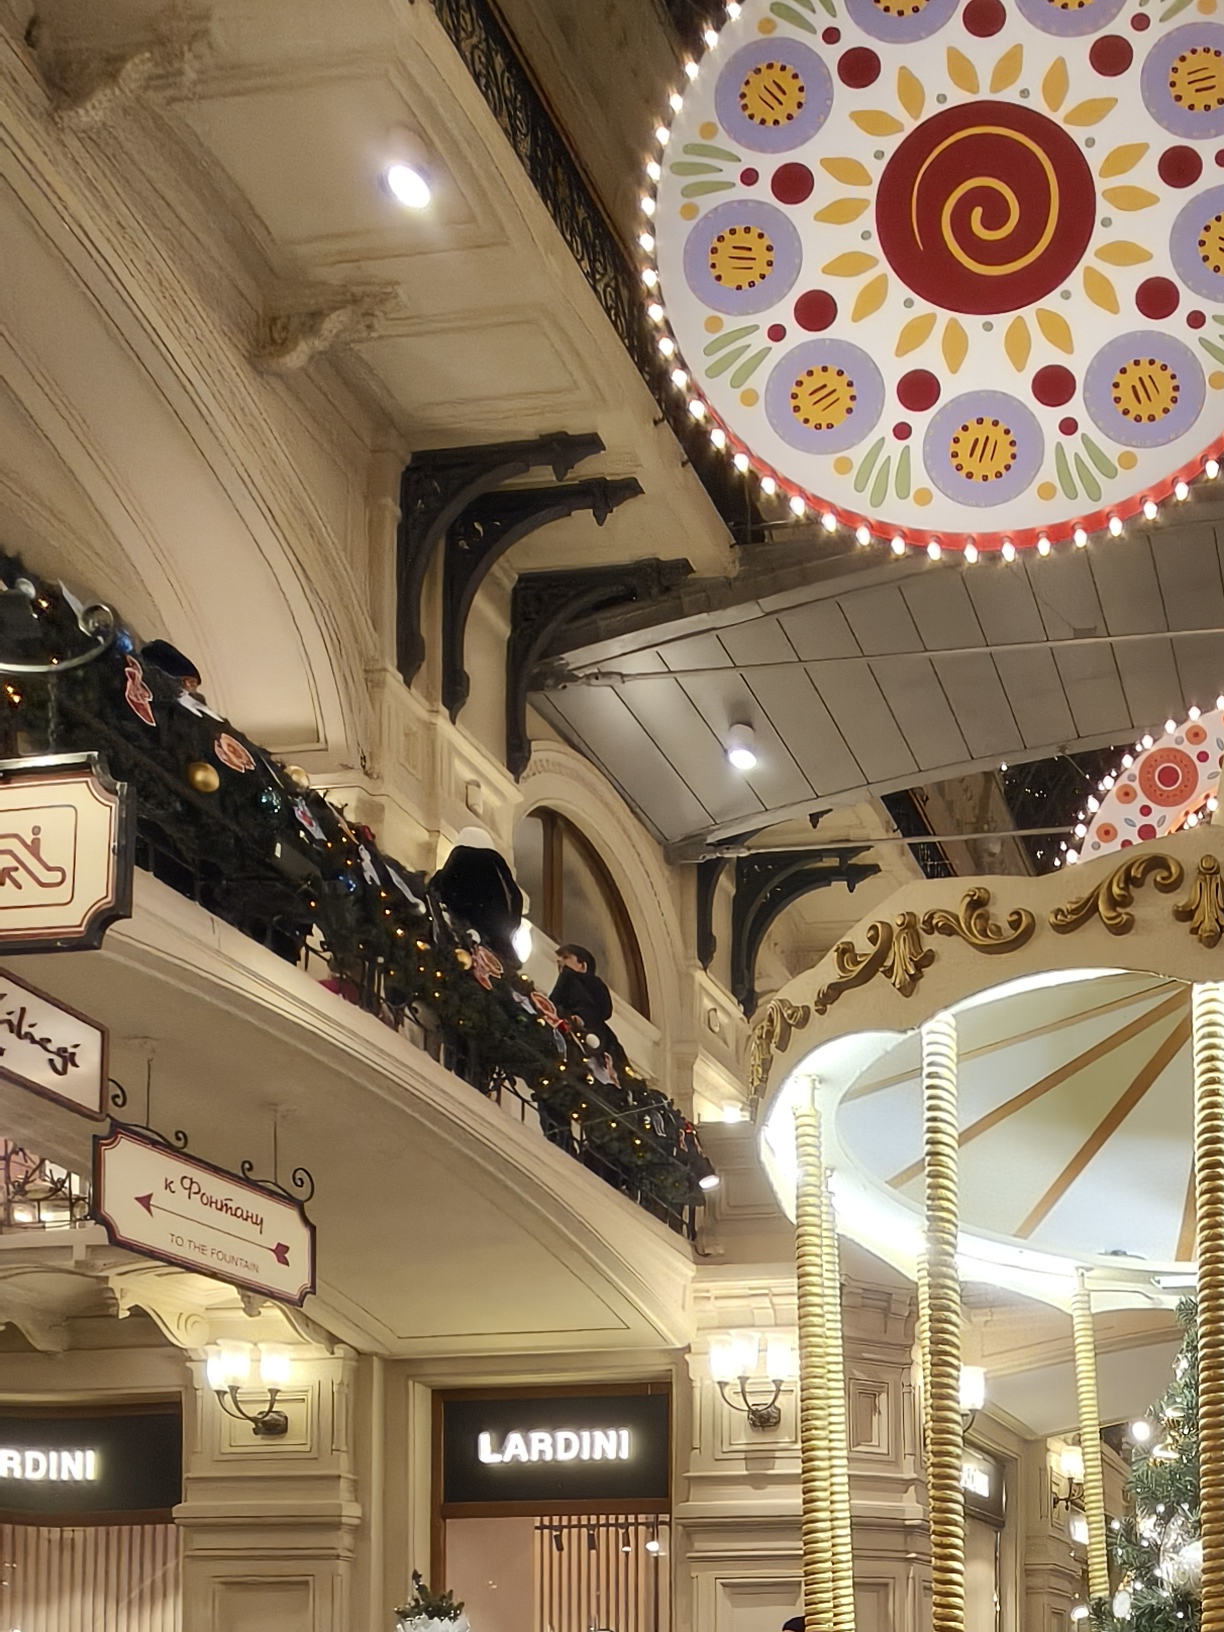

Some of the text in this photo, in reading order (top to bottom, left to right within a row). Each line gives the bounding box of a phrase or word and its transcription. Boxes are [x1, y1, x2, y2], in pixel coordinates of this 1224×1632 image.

[164, 1175, 264, 1235] к Фонтану
[169, 1233, 260, 1273] TO THE FOUNTAIN
[0, 1448, 96, 1481] RDINI
[478, 1429, 630, 1464] LARDINI
